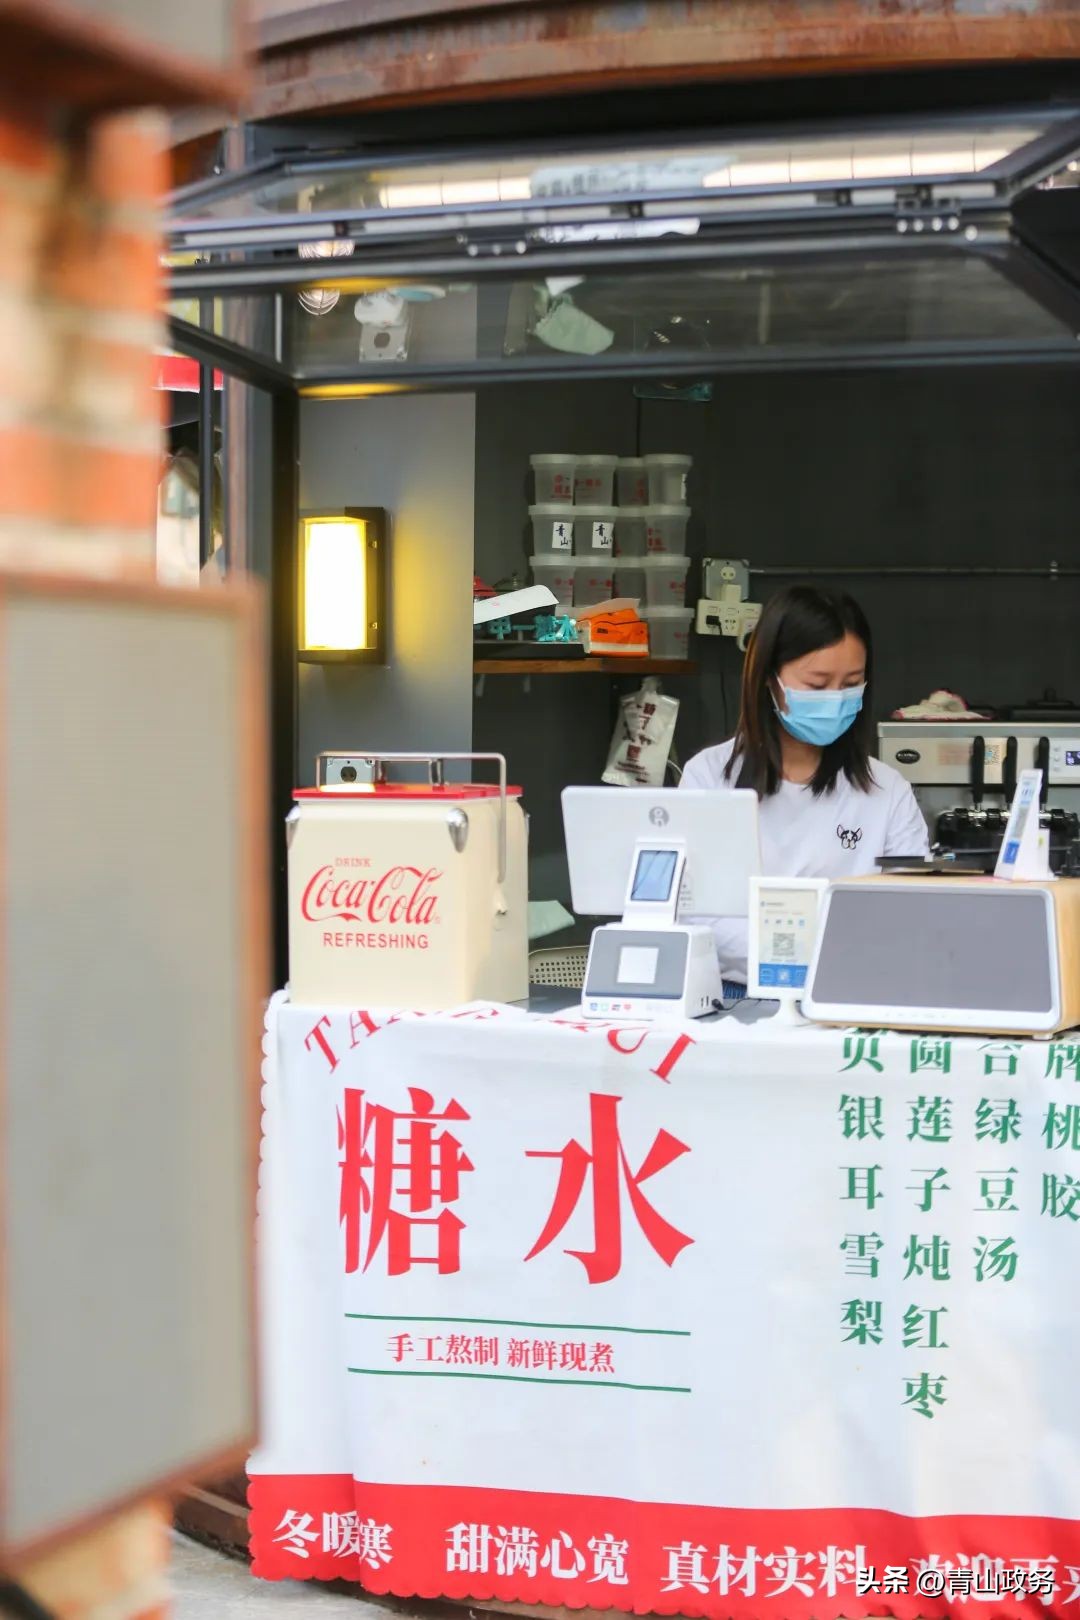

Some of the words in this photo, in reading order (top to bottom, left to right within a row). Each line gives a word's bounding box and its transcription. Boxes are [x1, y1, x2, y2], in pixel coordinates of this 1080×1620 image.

[335, 857, 371, 868] DRINK
[323, 932, 429, 950] REFRESHING
[386, 1332, 499, 1367] 手工熬制
[506, 1336, 616, 1374] 新鲜现煮
[444, 1521, 630, 1586] 甜满心宽
[659, 1540, 867, 1598] 真材实料
